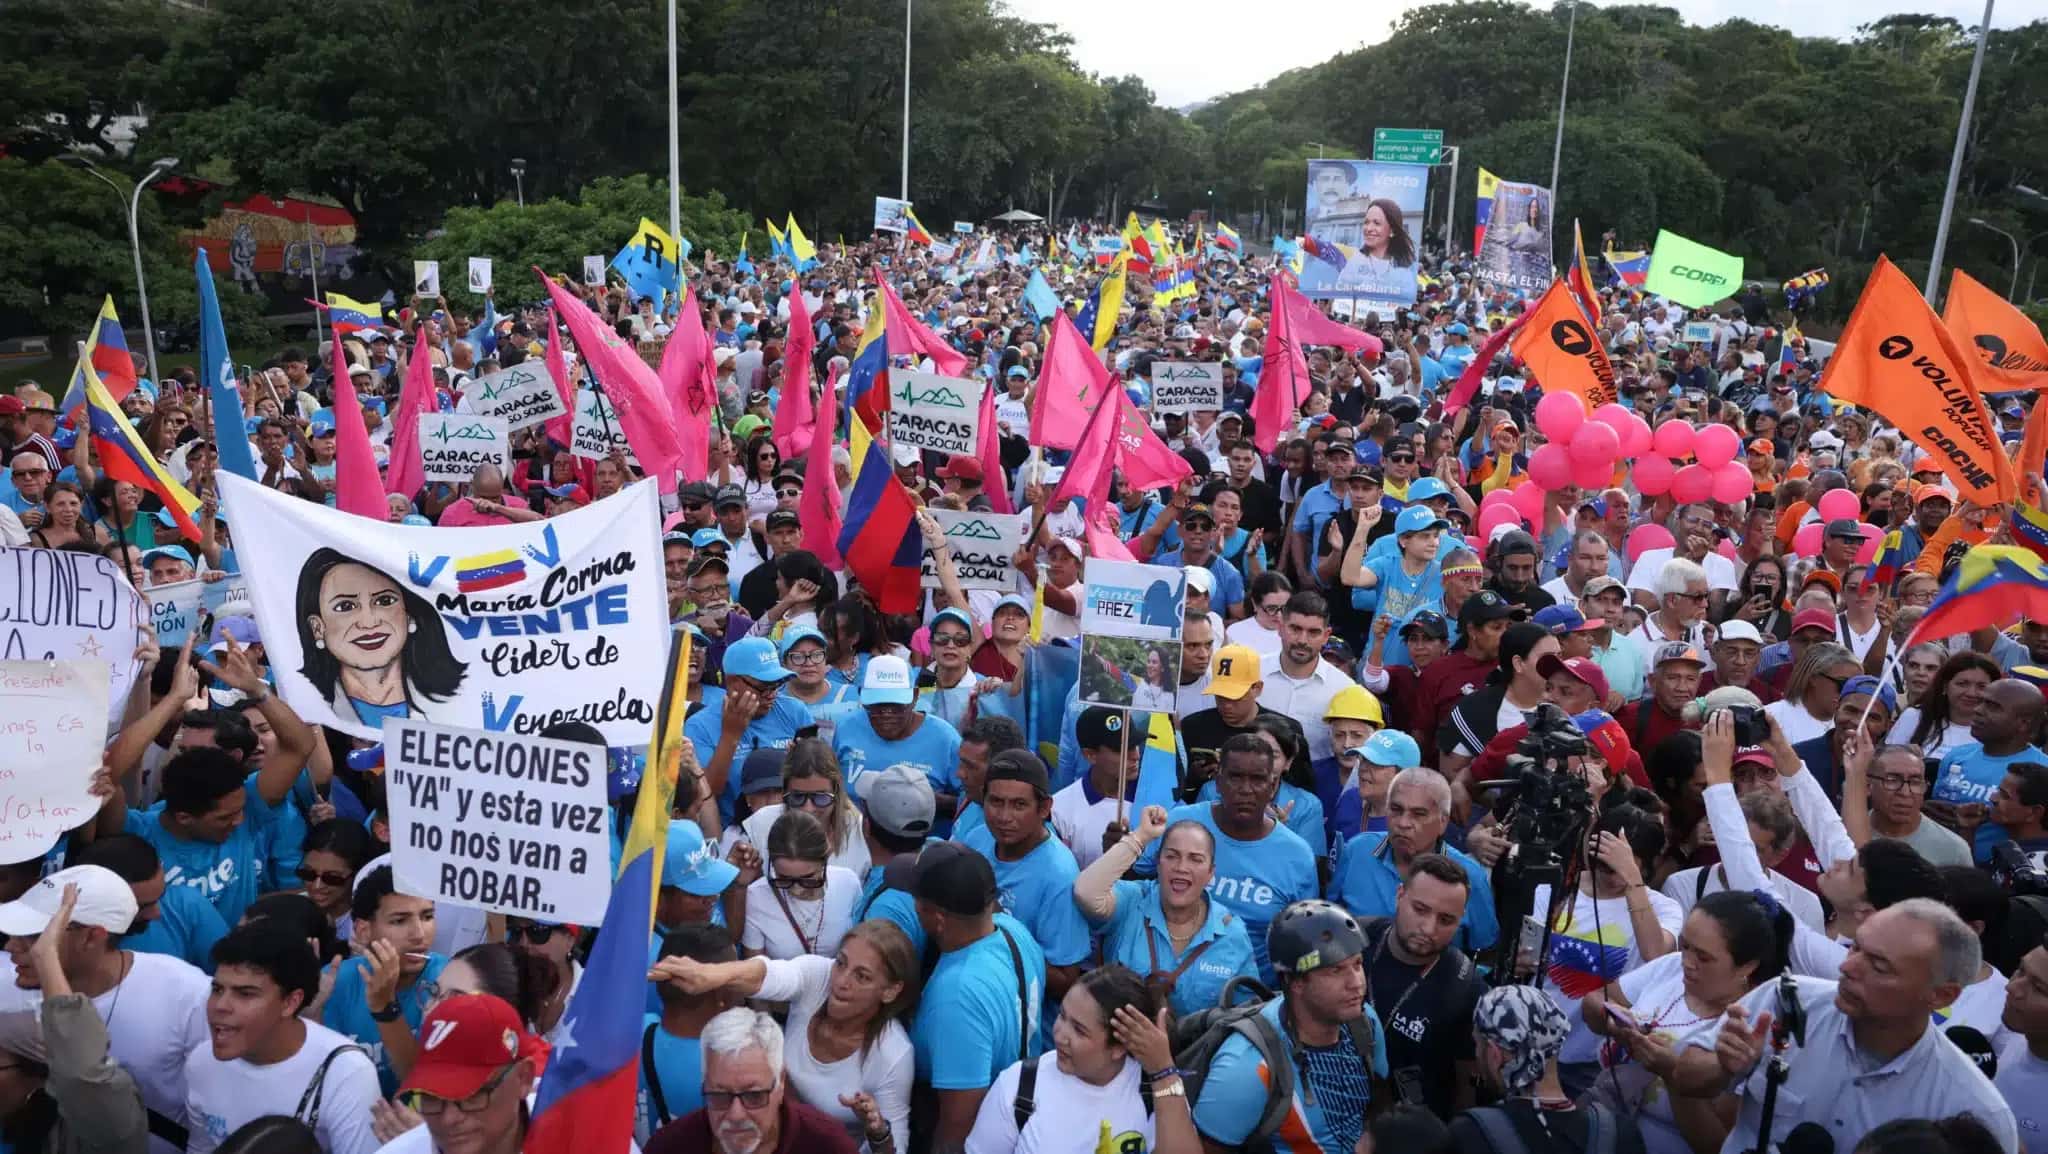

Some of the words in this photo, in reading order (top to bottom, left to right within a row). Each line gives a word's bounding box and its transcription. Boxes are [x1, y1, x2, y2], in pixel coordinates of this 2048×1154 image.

[1476, 268, 1517, 284] HASTA
[1520, 275, 1533, 287] EL
[1156, 386, 1218, 397] CARACAS
[523, 402, 557, 416] SOCIAL
[1157, 397, 1186, 406] PULSO
[1188, 396, 1217, 405] SOCIAL
[575, 438, 605, 454] PULSO
[926, 437, 969, 453] SOCIAL
[423, 449, 503, 466] CARACAS
[1921, 426, 1996, 490] COCHE
[424, 463, 461, 475] PULSO
[541, 550, 636, 608] Corina
[957, 566, 1006, 582] SOCIAL
[1092, 586, 1143, 601] Vente
[443, 583, 629, 641] VENTE
[585, 635, 619, 667] de
[876, 670, 904, 681] Vente
[480, 691, 654, 735] Venezuela
[400, 729, 591, 788] ELECCIONES
[393, 769, 451, 811] "YA"
[455, 788, 473, 823] y
[480, 790, 543, 826] esta
[551, 802, 603, 834] vez
[410, 821, 443, 852] no
[450, 829, 500, 863] nos
[508, 838, 561, 871] van
[569, 847, 588, 875] a
[439, 863, 556, 914] ROBAR..
[1199, 961, 1233, 976] Vente
[1396, 1012, 1407, 1025] LA
[424, 1020, 457, 1050] V
[1392, 1021, 1421, 1042] CALLE
